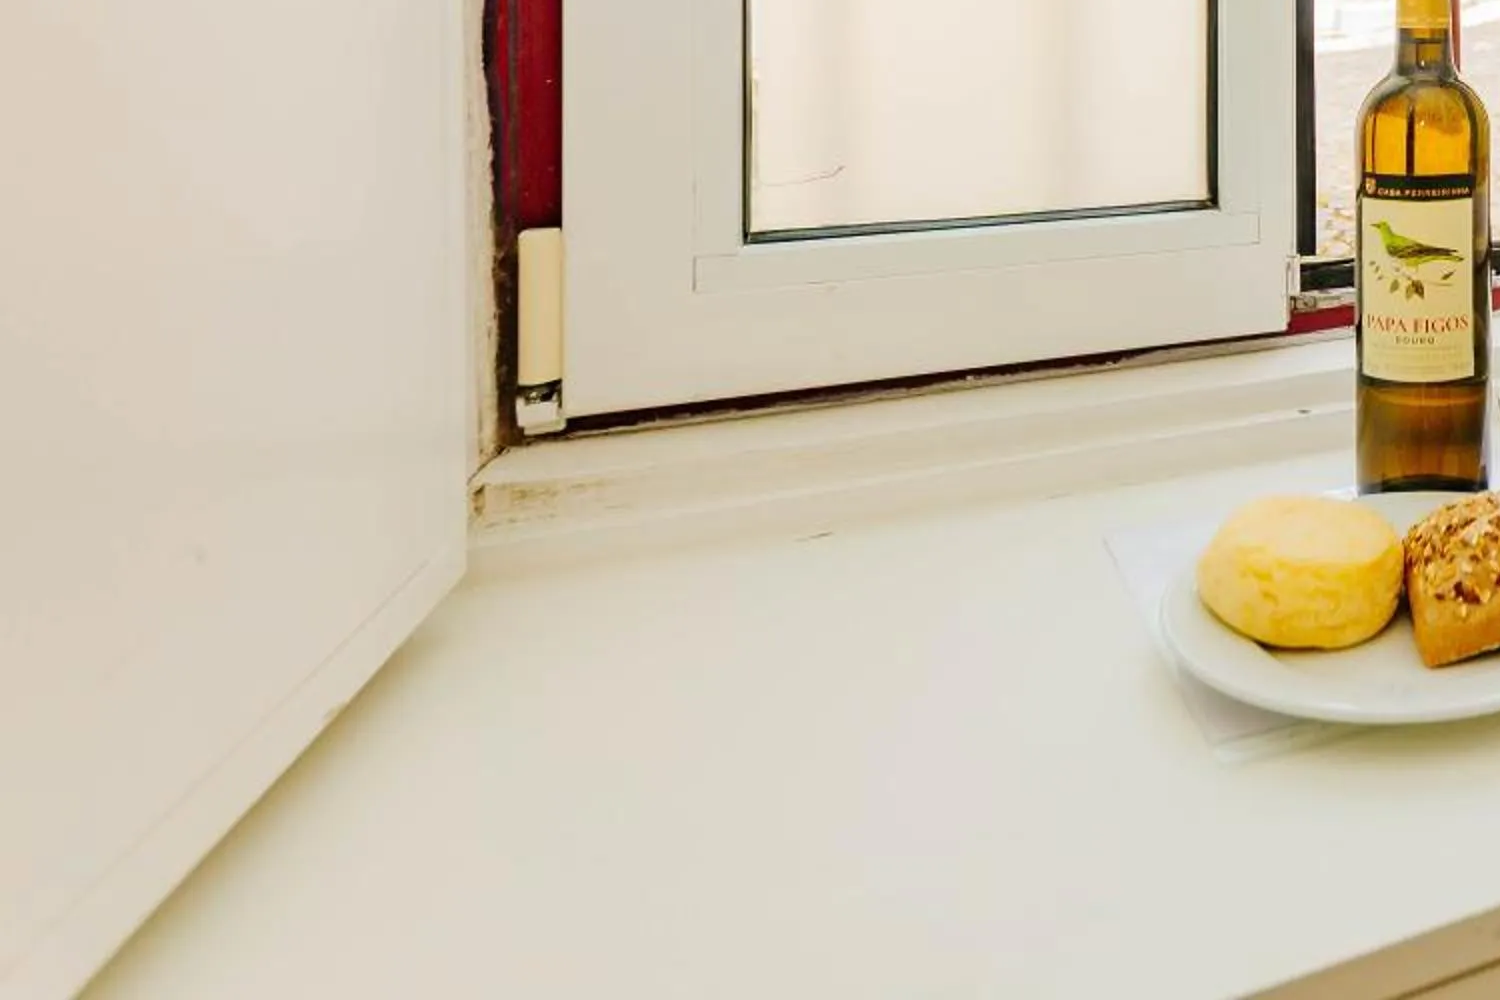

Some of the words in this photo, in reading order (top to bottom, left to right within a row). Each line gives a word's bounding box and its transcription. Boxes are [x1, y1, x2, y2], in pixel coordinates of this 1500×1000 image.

[1377, 187, 1402, 196] CASA
[1367, 314, 1407, 333] PAPA
[1413, 313, 1469, 333] FIGOS
